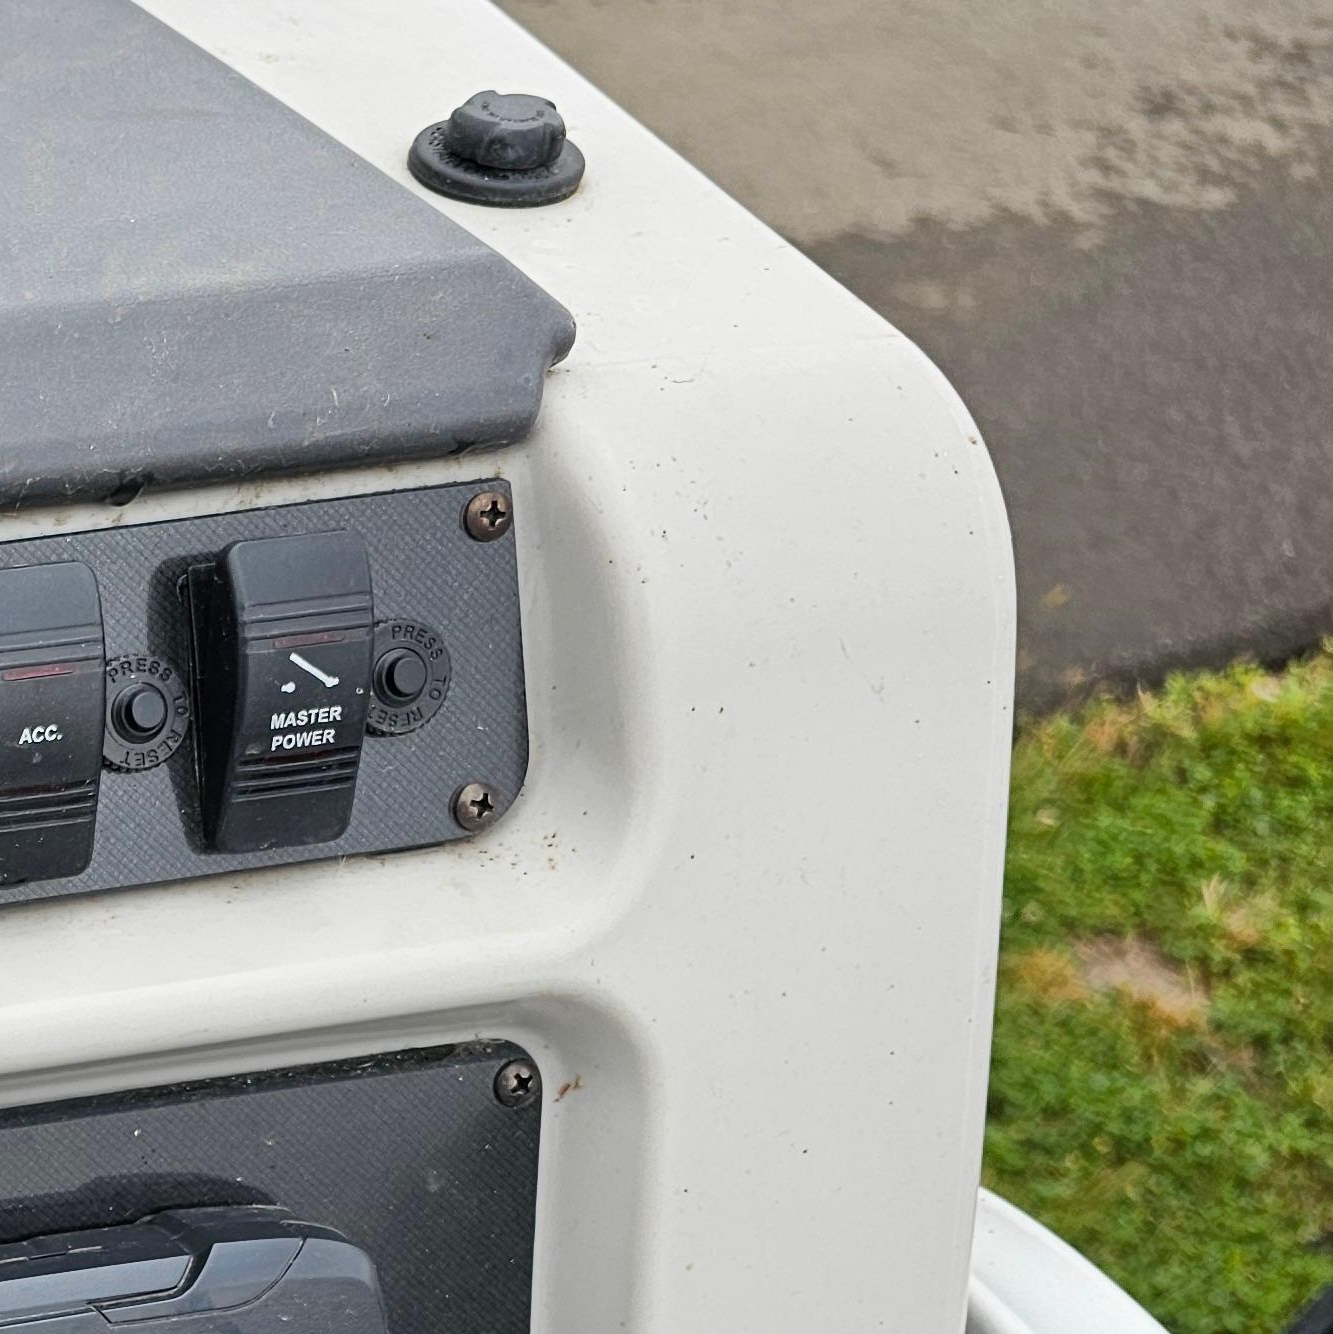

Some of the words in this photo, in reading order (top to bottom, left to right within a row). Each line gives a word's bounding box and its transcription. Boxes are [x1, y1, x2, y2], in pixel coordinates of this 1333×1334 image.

[392, 625, 443, 659] PRESS
[108, 658, 172, 683] PRESS
[429, 676, 446, 699] TO
[270, 706, 342, 730] MASTER
[368, 707, 423, 727] RESE
[18, 724, 62, 745] ACC.
[271, 729, 335, 751] POWER
[120, 730, 181, 766] RESET
